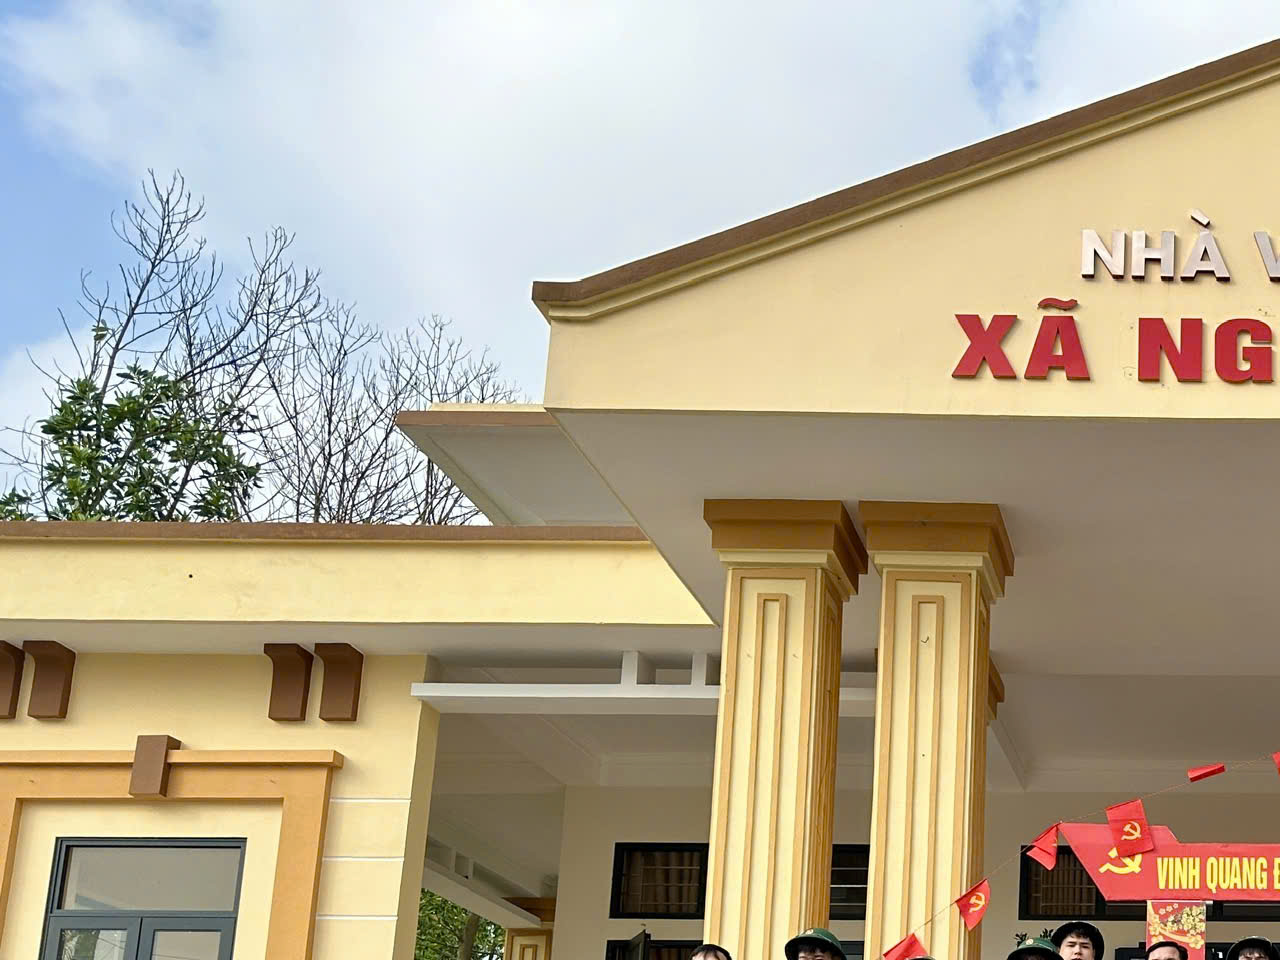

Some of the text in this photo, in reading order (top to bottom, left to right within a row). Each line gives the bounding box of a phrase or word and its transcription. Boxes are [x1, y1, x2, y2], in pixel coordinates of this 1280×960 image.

[1081, 210, 1231, 282] NHÀ
[952, 297, 1091, 381] XÃ
[1157, 856, 1200, 889] VINH
[1206, 856, 1268, 894] QUANG
